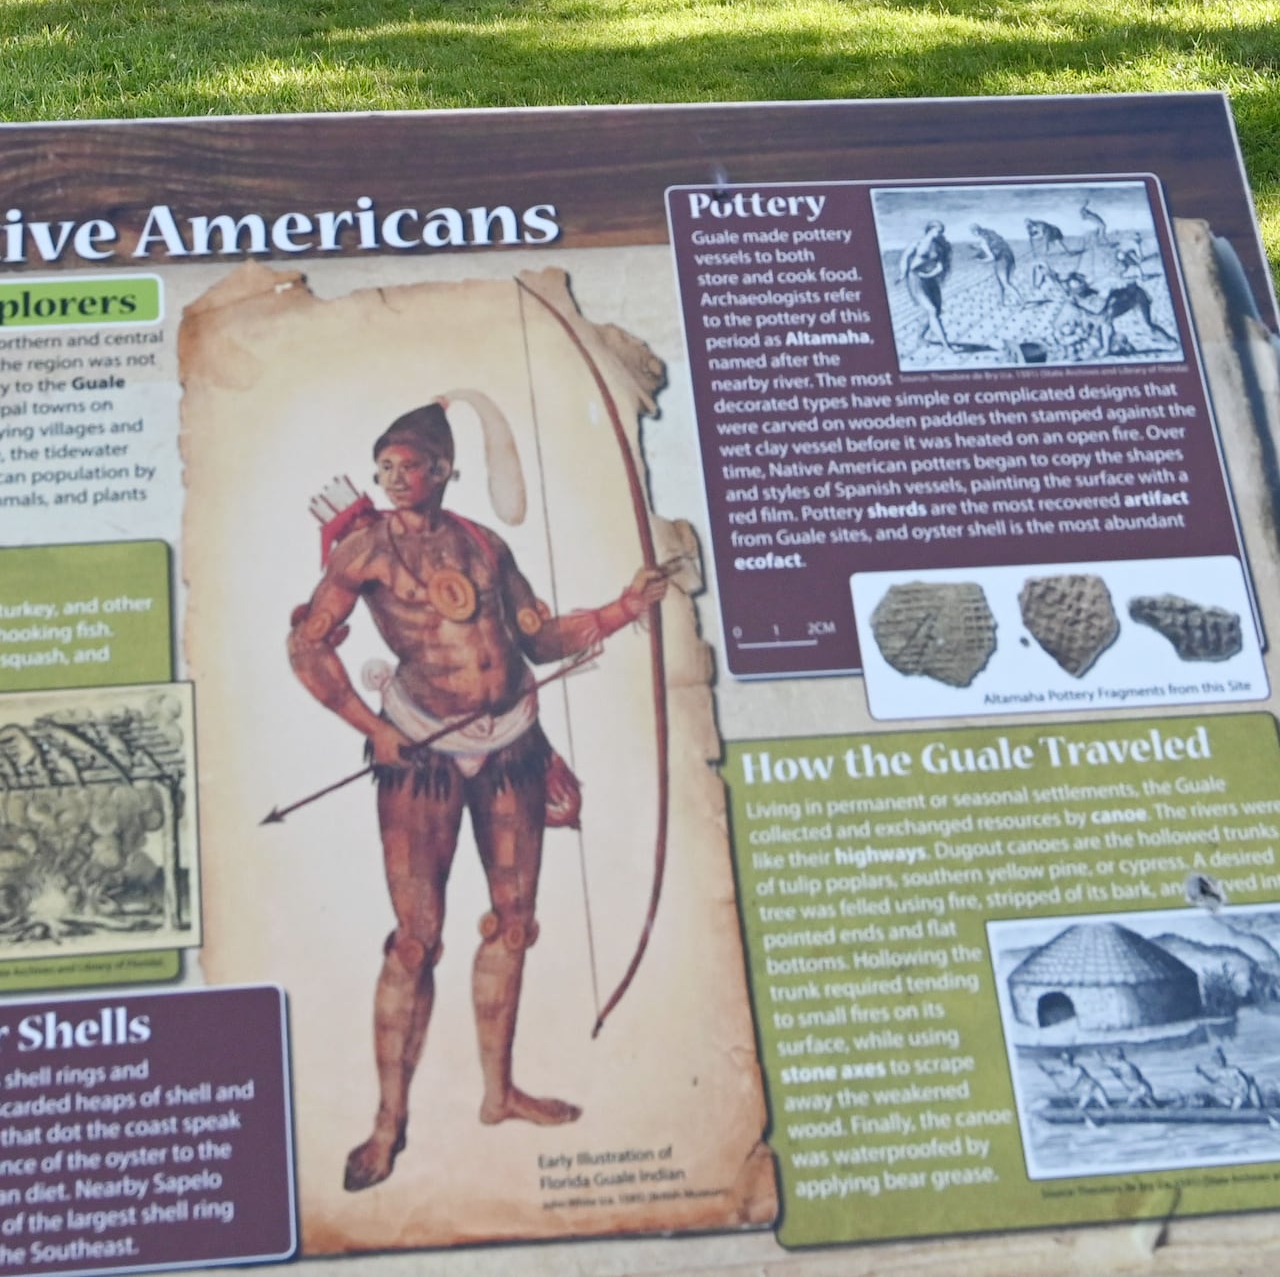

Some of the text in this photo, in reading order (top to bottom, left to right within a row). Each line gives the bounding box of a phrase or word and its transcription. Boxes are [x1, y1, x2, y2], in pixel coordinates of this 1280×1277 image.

[687, 192, 826, 222] Pottery
[131, 196, 561, 260] Americans
[691, 228, 852, 246] Guale made pottery
[693, 247, 815, 266] vessels to both
[697, 266, 862, 287] store and cook food.
[700, 287, 861, 307] Archaeologists refer
[702, 308, 871, 329] to the pottery of this
[66, 333, 100, 348] and
[104, 329, 164, 346] central
[705, 329, 874, 352] period as Altamaha,
[27, 358, 84, 374] region
[88, 356, 122, 368] was
[126, 352, 156, 367] not
[708, 351, 841, 371] named after the
[711, 375, 769, 393] nearby
[773, 375, 813, 389] river.
[815, 372, 847, 388] The
[850, 372, 893, 387] most
[713, 382, 1178, 414] decorated types have simple or complicated designs that
[728, 490, 1190, 525] red film. Pottery sherds are the most recovered artifact
[734, 553, 806, 571] ecofact.
[62, 596, 100, 615] and
[102, 595, 153, 614] other
[983, 679, 1252, 706] Altamaha Pottery Fragments from this Site
[741, 726, 1212, 785] How the Guale Traveled
[745, 775, 1227, 820] Living in permanent or seasonal settlements, the Guale
[749, 823, 832, 845] collected
[836, 820, 871, 839] and
[875, 815, 973, 837] exchanged
[977, 813, 1061, 831] resources
[1063, 809, 1086, 829] by
[1090, 808, 1150, 824] canoe.
[1152, 802, 1187, 819] The
[1190, 802, 1238, 817] rivers
[17, 1006, 152, 1052] Shells
[4, 1066, 52, 1089] shell
[55, 1066, 106, 1087] rings
[109, 1059, 150, 1081] and
[75, 1093, 136, 1112] heaps
[139, 1085, 162, 1107] of
[165, 1082, 212, 1105] shell
[215, 1079, 255, 1101] and
[538, 1144, 673, 1169] Early Illustration of
[539, 1167, 686, 1190] Florida Guale Indian
